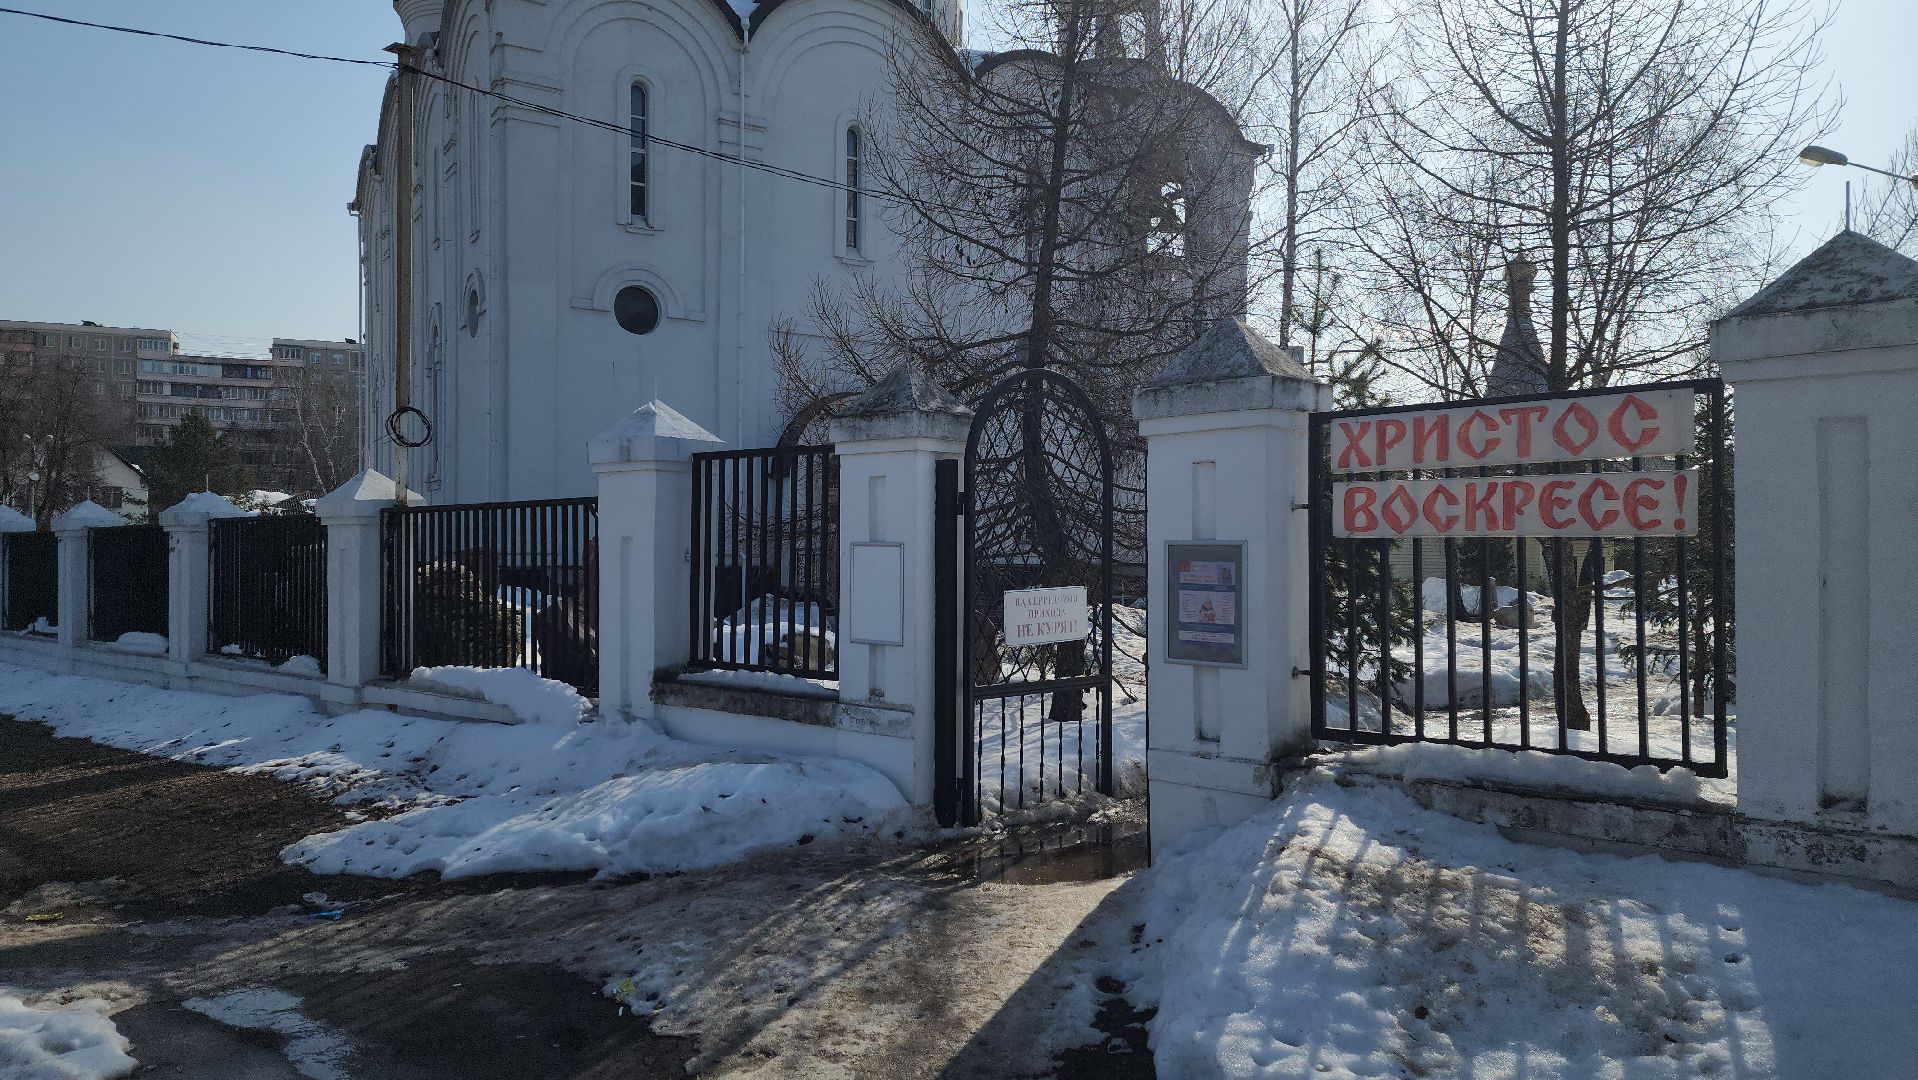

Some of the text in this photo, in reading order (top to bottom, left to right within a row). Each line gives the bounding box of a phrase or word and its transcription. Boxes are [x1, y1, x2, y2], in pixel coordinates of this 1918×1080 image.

[1337, 394, 1660, 469] ХРИСТОС
[1343, 474, 1688, 534] ВОСКРЕСЕ!
[1017, 623, 1034, 637] НЕ
